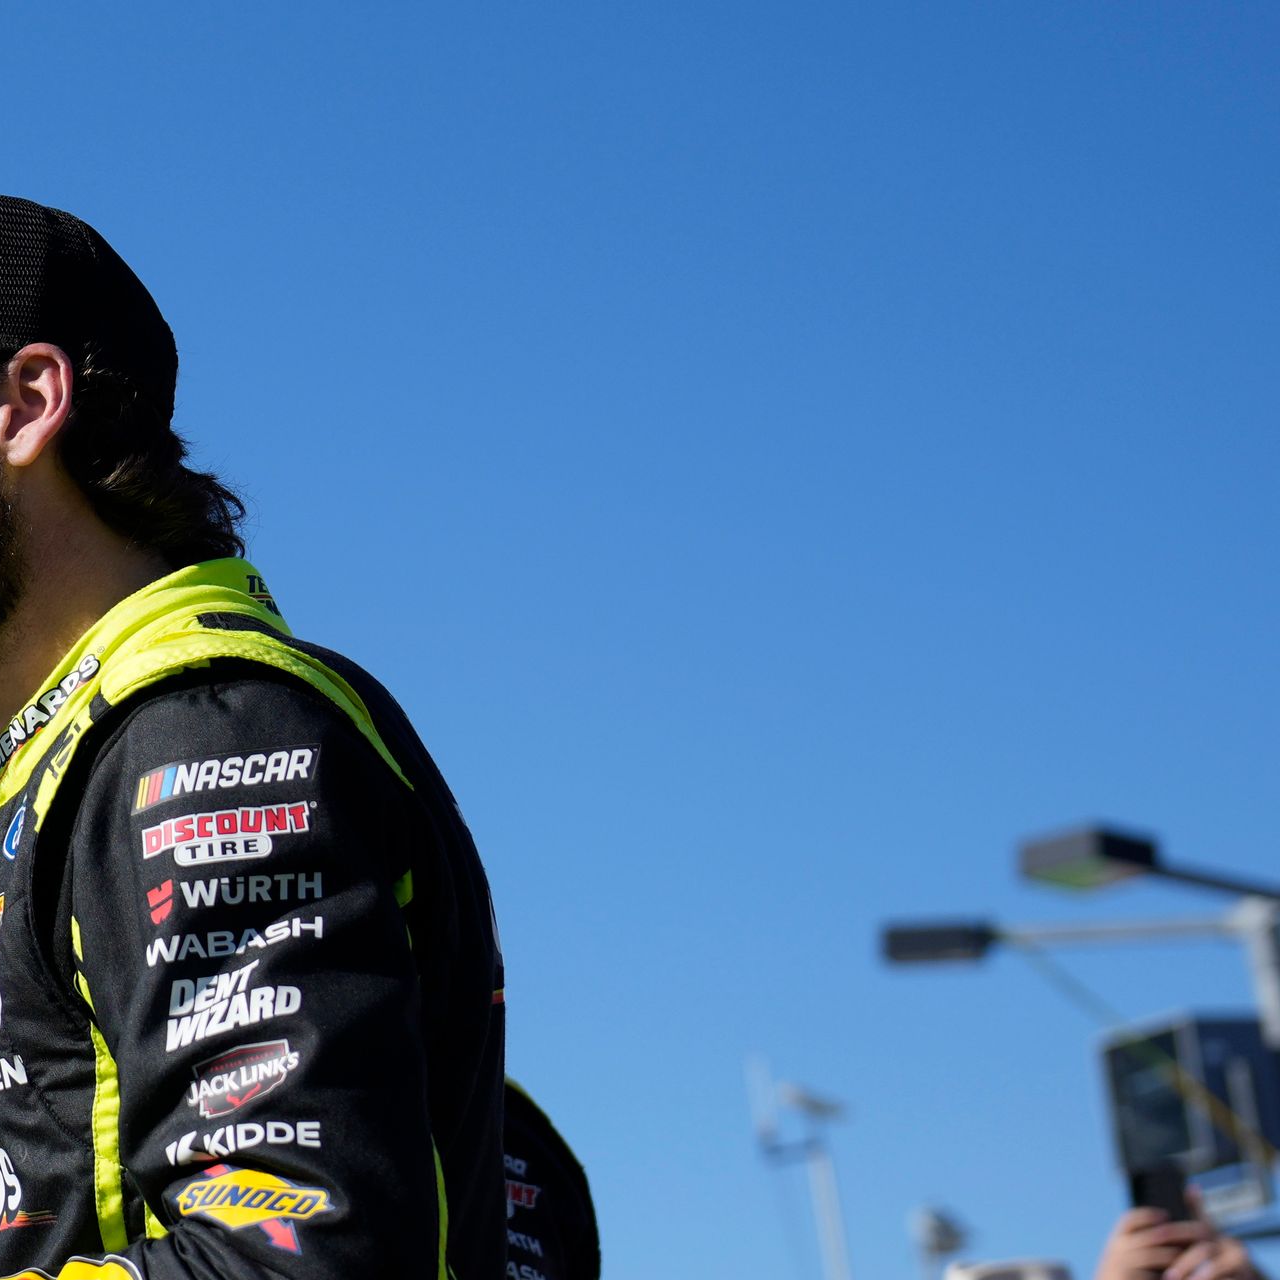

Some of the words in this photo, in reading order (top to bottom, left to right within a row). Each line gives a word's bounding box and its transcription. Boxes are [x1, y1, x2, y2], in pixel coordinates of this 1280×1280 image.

[172, 749, 313, 796] NASCAR
[142, 801, 309, 859] DISCOUNT
[185, 838, 259, 860] TIRE
[180, 872, 323, 909] WÜRTH
[146, 916, 323, 967] WABASH
[169, 959, 260, 1016] DENT
[166, 986, 302, 1052] WIZARD
[188, 1073, 240, 1107] JACK
[240, 1051, 300, 1086] LINK'S
[203, 1121, 322, 1157] KIDDE
[183, 1184, 322, 1214] SUNOCO
